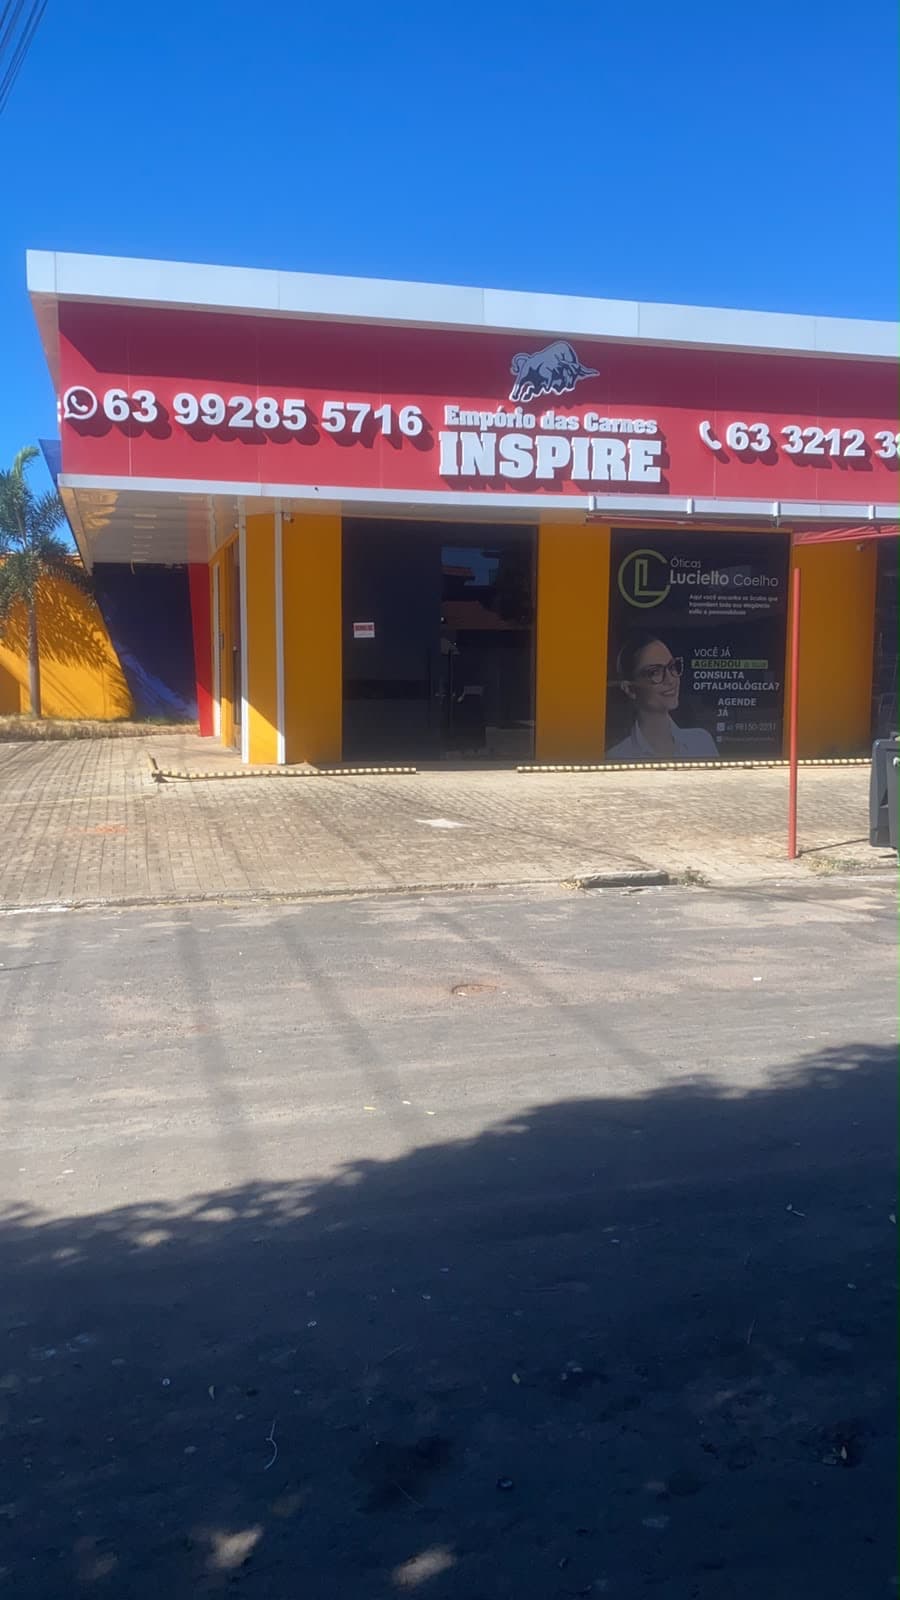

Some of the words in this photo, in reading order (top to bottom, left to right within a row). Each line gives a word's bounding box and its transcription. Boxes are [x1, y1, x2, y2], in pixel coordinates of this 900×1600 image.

[103, 388, 158, 423] 63
[172, 393, 308, 431] 99285
[321, 400, 423, 436] 5716
[444, 405, 535, 432] Empório
[540, 409, 580, 431] das
[583, 412, 658, 435] Carnes
[726, 421, 772, 452] 63
[780, 424, 866, 457] 3212
[873, 431, 900, 459] 3
[438, 431, 662, 483] INSPIRE
[733, 574, 779, 588] Coelho
[693, 646, 718, 657] VOCÊ
[719, 646, 731, 657] JÁ
[693, 660, 741, 669] AGENDOU
[693, 671, 745, 679] CONSULTA
[692, 680, 780, 691] OFTALMOLÓGICA?
[717, 698, 757, 706] AGENDE
[716, 706, 729, 717] JÁ
